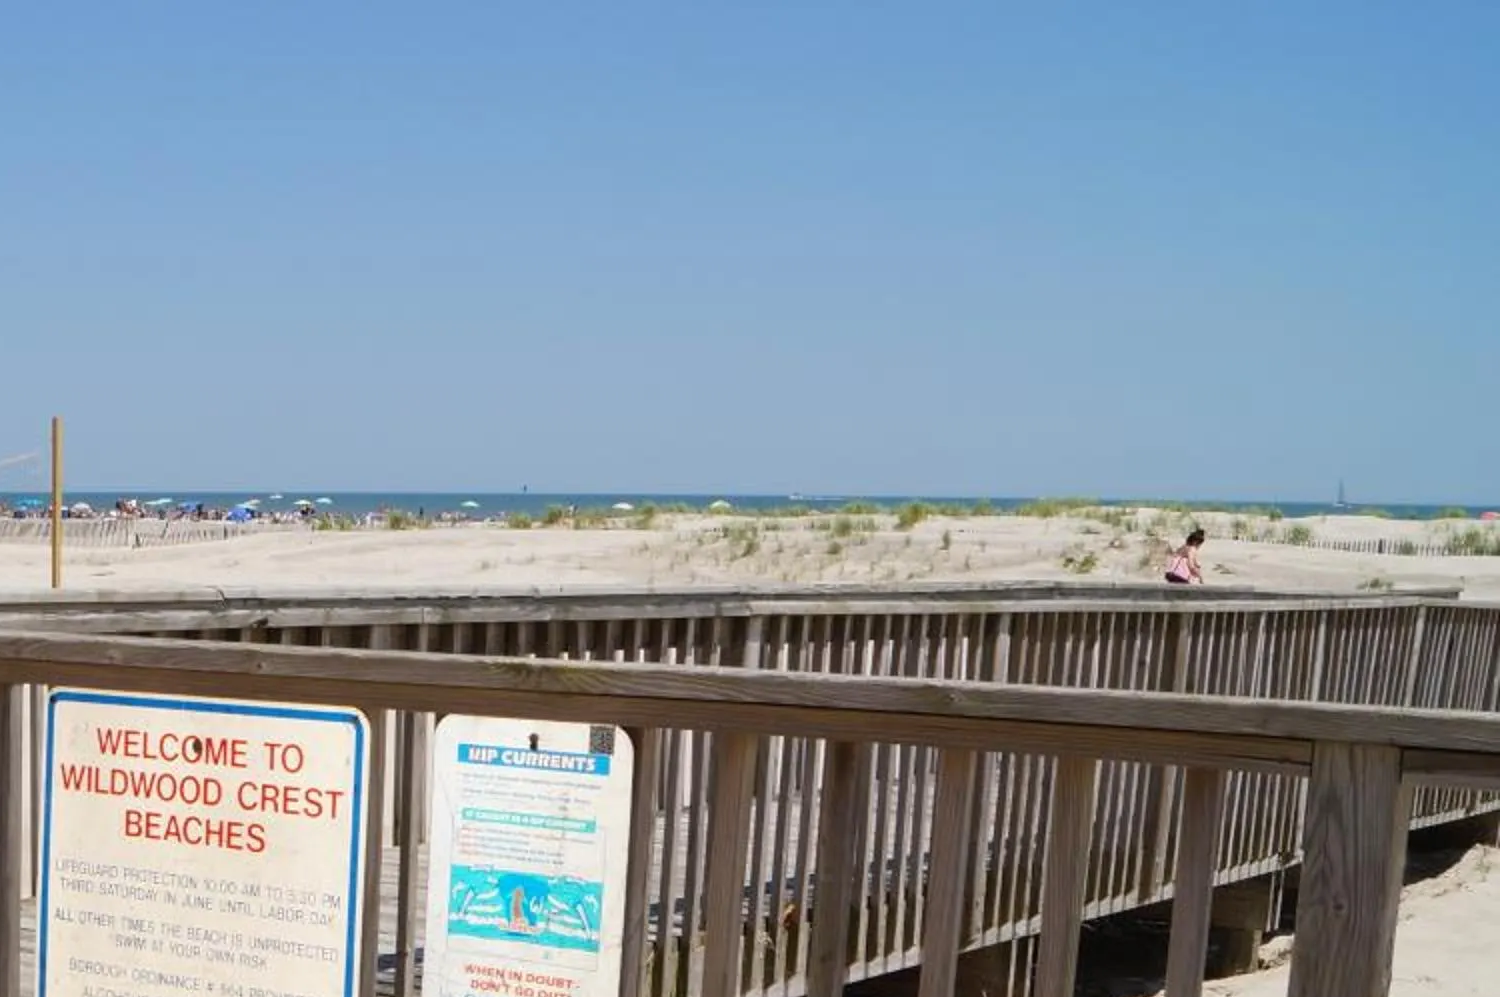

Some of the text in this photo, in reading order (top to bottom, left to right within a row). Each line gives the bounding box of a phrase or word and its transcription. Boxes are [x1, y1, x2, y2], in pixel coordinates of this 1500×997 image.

[97, 727, 305, 774] WELCOME TO
[501, 749, 597, 772] CURRENTS
[60, 763, 345, 820] WILDWOOD CREST
[124, 808, 266, 854] BEACHES
[100, 881, 158, 901] SATURDAY
[164, 890, 177, 905] IN
[181, 894, 214, 912] JUNE
[123, 866, 197, 889] PROTECTION
[321, 892, 341, 910] PM
[54, 907, 74, 923] ALL
[78, 910, 115, 928] OTHER
[121, 916, 156, 934] TIMES
[161, 923, 182, 939] THE
[187, 926, 228, 945] BEACH
[248, 934, 339, 962] UNPROTECTED
[116, 934, 267, 970] SWIM AT YOUR OWN RISK
[131, 967, 201, 992] ORDINANCE
[464, 964, 505, 979] WHEN
[508, 970, 523, 982] IN
[470, 979, 511, 994] DON'T
[514, 985, 535, 997] GO
